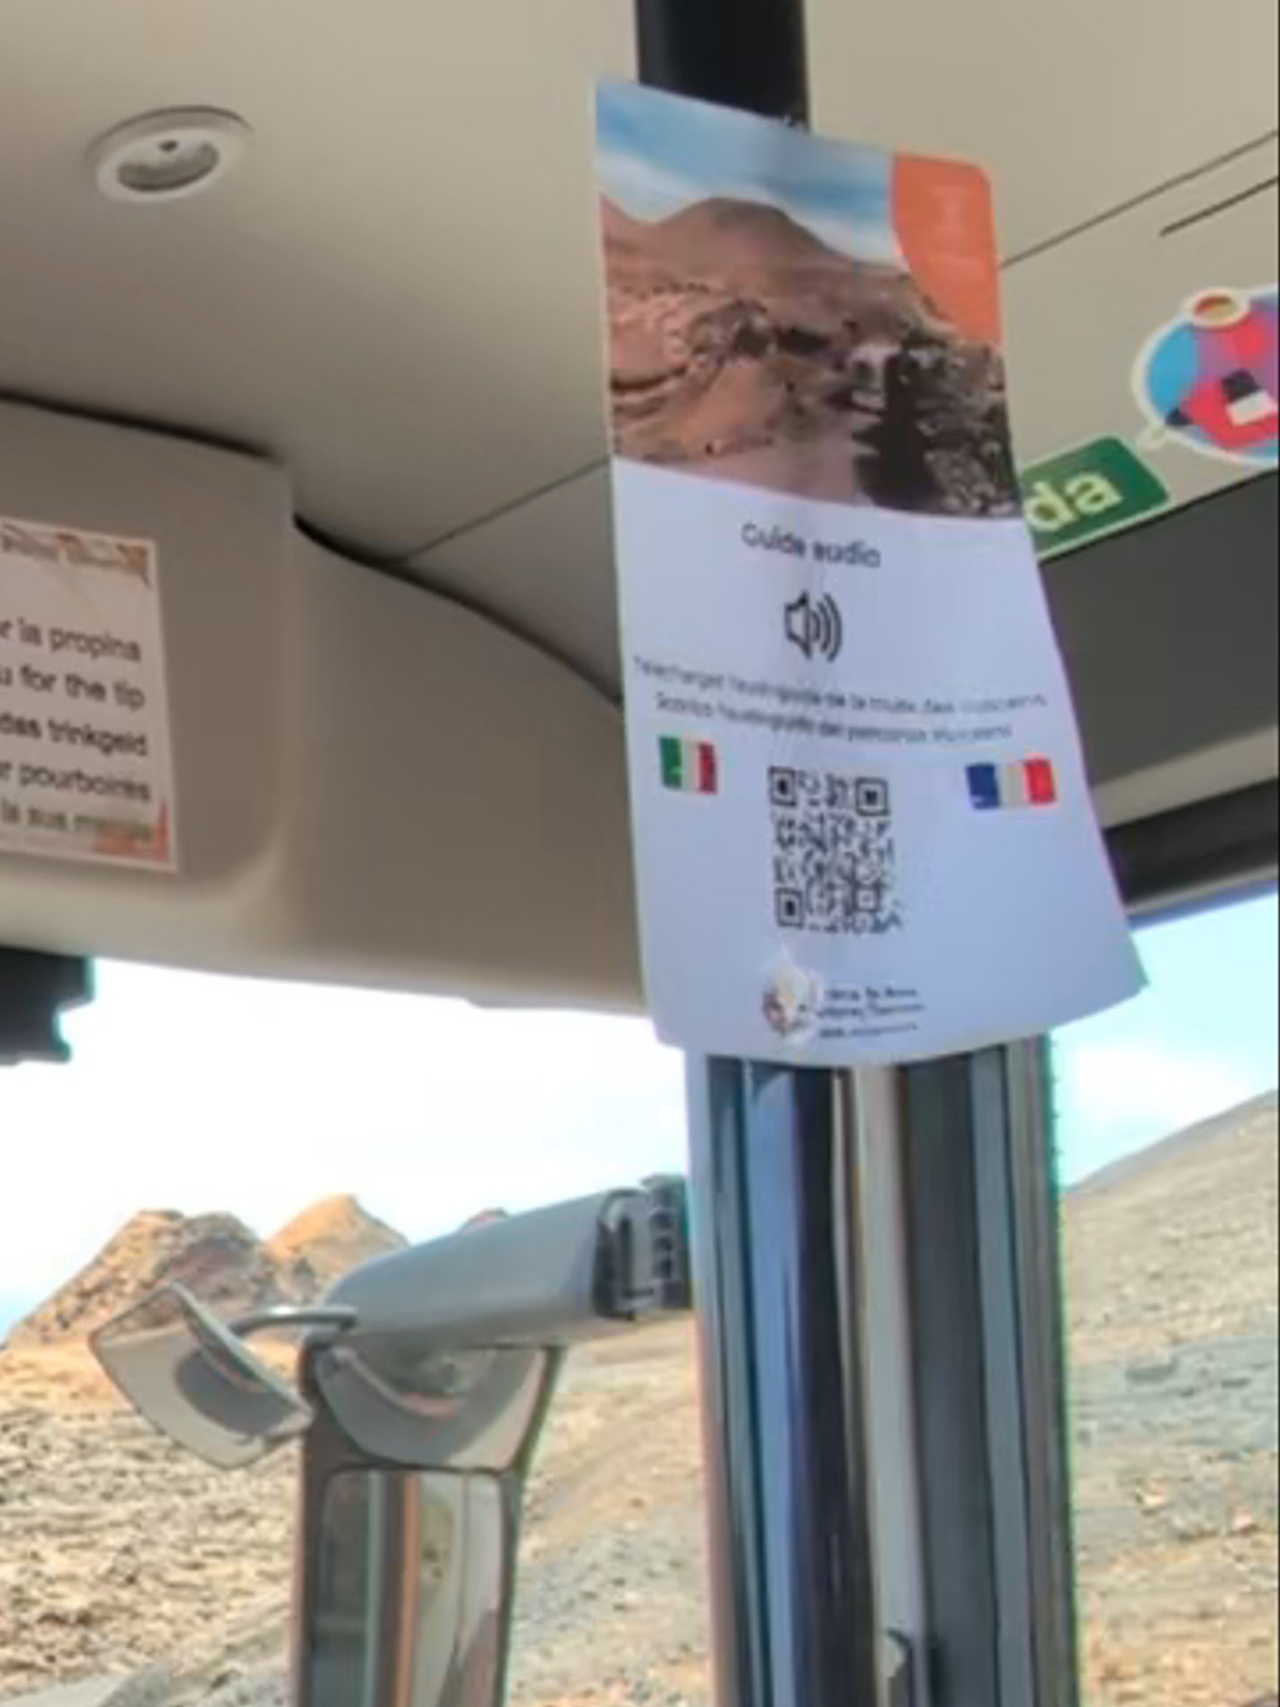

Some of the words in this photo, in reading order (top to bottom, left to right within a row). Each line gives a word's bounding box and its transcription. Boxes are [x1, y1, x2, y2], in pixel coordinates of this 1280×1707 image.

[741, 523, 806, 557] Guide
[813, 537, 882, 567] audio
[19, 618, 42, 646] la
[50, 625, 142, 662] propina
[20, 663, 57, 692] for
[65, 670, 107, 702] the
[114, 678, 146, 711] tip
[48, 716, 148, 758] trinkgeld
[19, 760, 151, 802] pourboires
